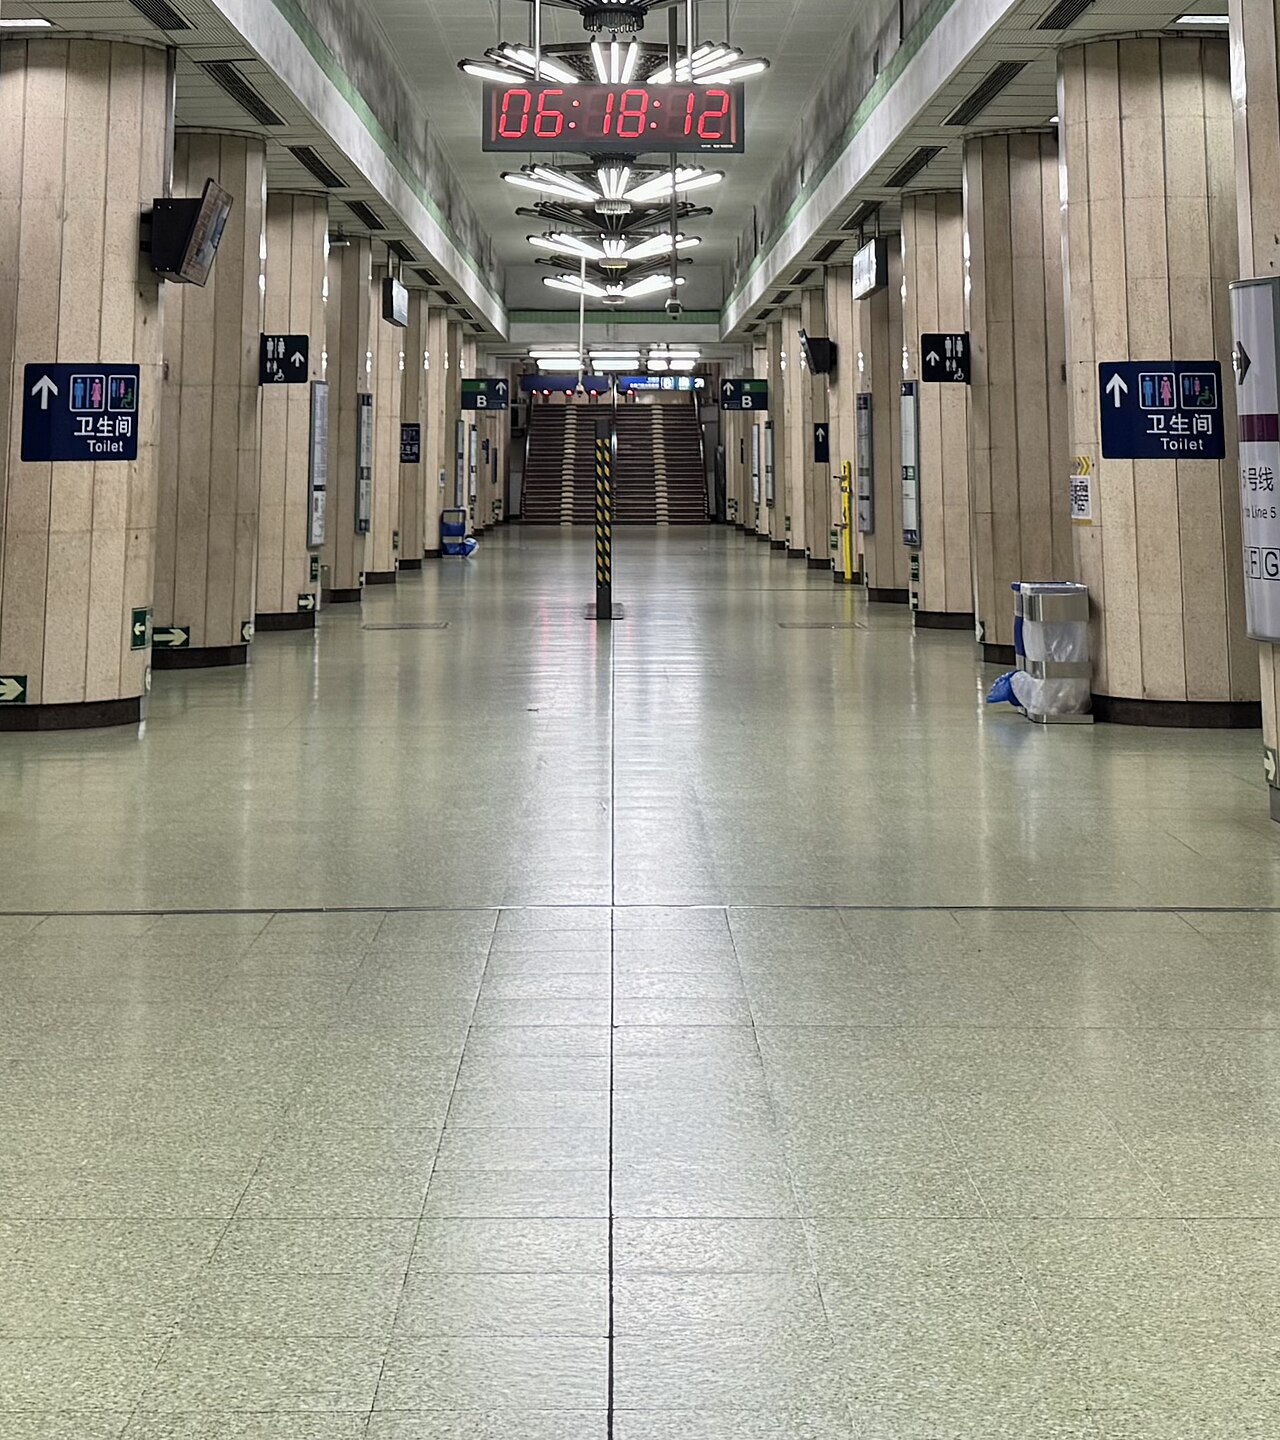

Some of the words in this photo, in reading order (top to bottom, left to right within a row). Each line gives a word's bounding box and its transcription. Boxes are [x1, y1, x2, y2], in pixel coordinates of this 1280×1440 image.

[497, 88, 730, 139] 06:18:12
[476, 395, 488, 408] B
[741, 395, 753, 408] B
[73, 415, 132, 438] 卫生间
[1146, 413, 1213, 435] 卫生间
[86, 439, 124, 453] Toilet
[1160, 437, 1204, 451] Toilet
[1251, 506, 1268, 519] Line
[1270, 506, 1277, 519] 5
[1264, 551, 1280, 578] G
